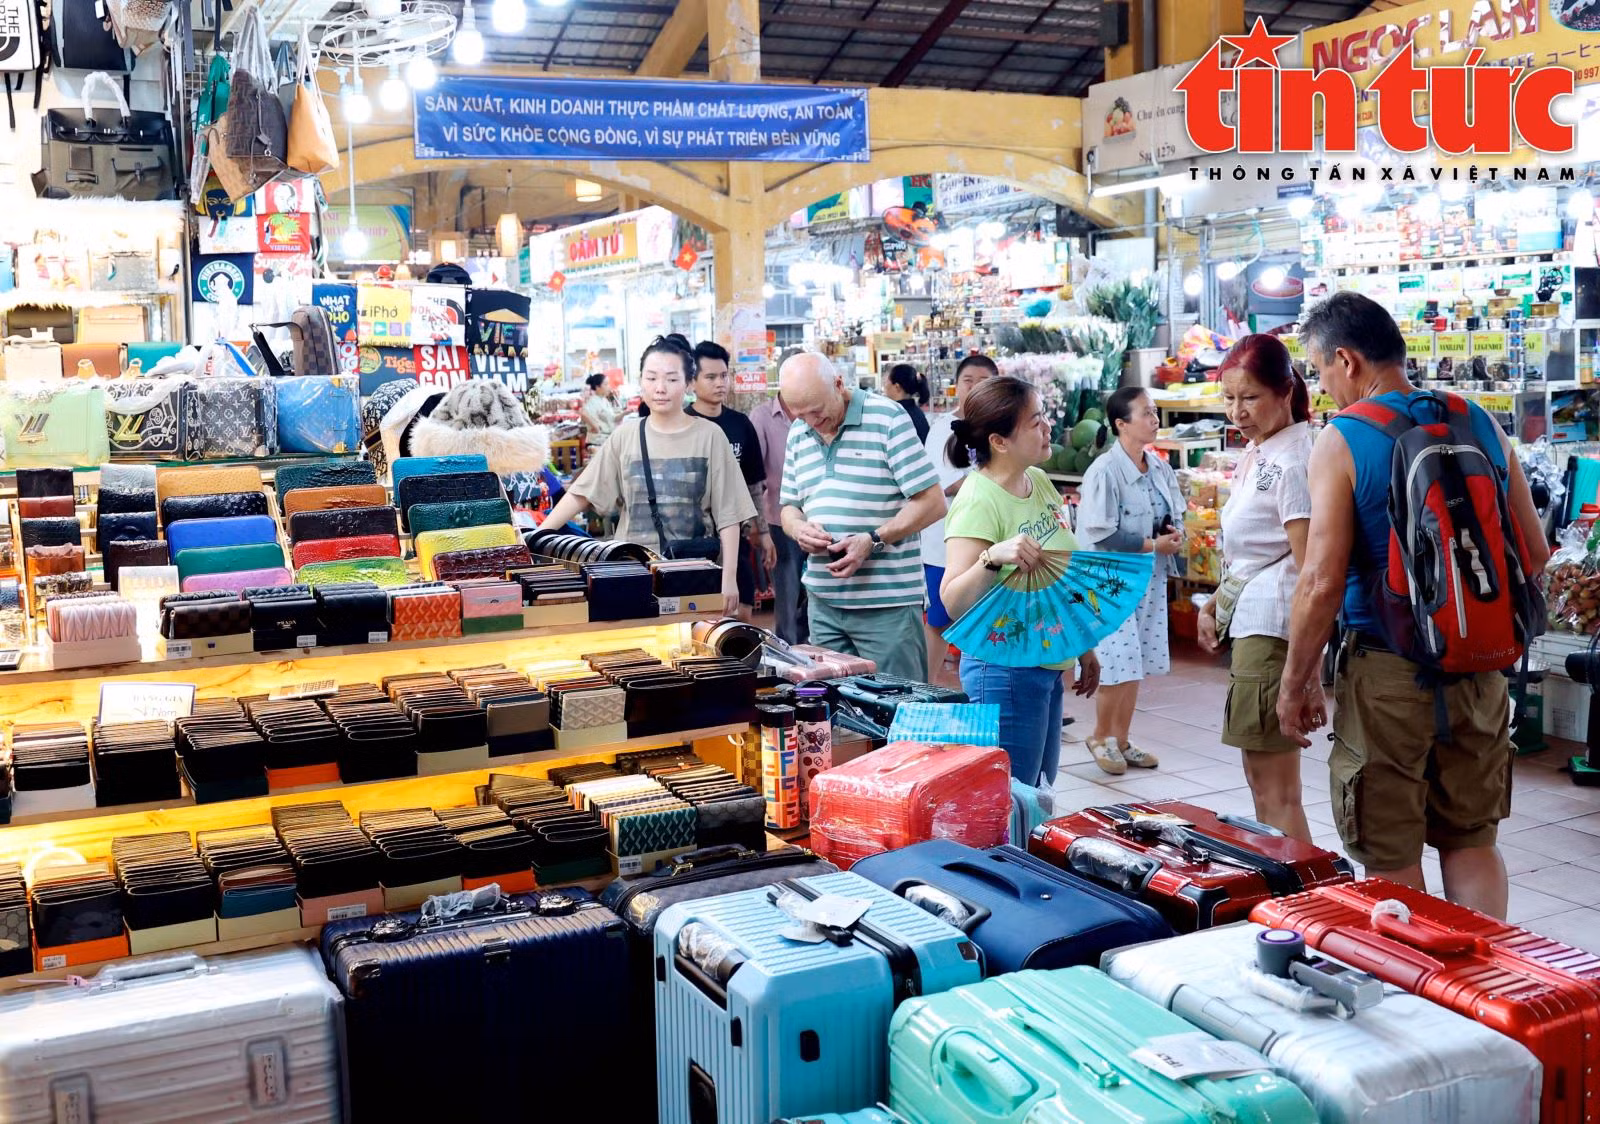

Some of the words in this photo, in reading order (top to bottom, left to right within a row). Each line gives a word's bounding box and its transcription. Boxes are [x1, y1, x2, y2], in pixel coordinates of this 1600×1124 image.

[425, 94, 457, 112] SẢN
[510, 99, 546, 114] KINH
[551, 99, 604, 115] DOANH
[608, 99, 648, 119] THỰC
[739, 103, 792, 122] LƯỢNG,
[795, 104, 814, 120] AN
[817, 102, 853, 120] TOÀN
[443, 123, 458, 142] VÌ
[462, 123, 496, 142] SỨC
[501, 124, 545, 143] KHỎE
[548, 126, 591, 147] CỘNG
[644, 127, 659, 146] VÌ
[662, 129, 684, 149] SỰ
[687, 127, 724, 147] PHÁT
[727, 128, 768, 147] TRIỂN
[802, 129, 841, 148] VỮNG
[320, 295, 350, 306] WHAT
[420, 345, 460, 370] SAI
